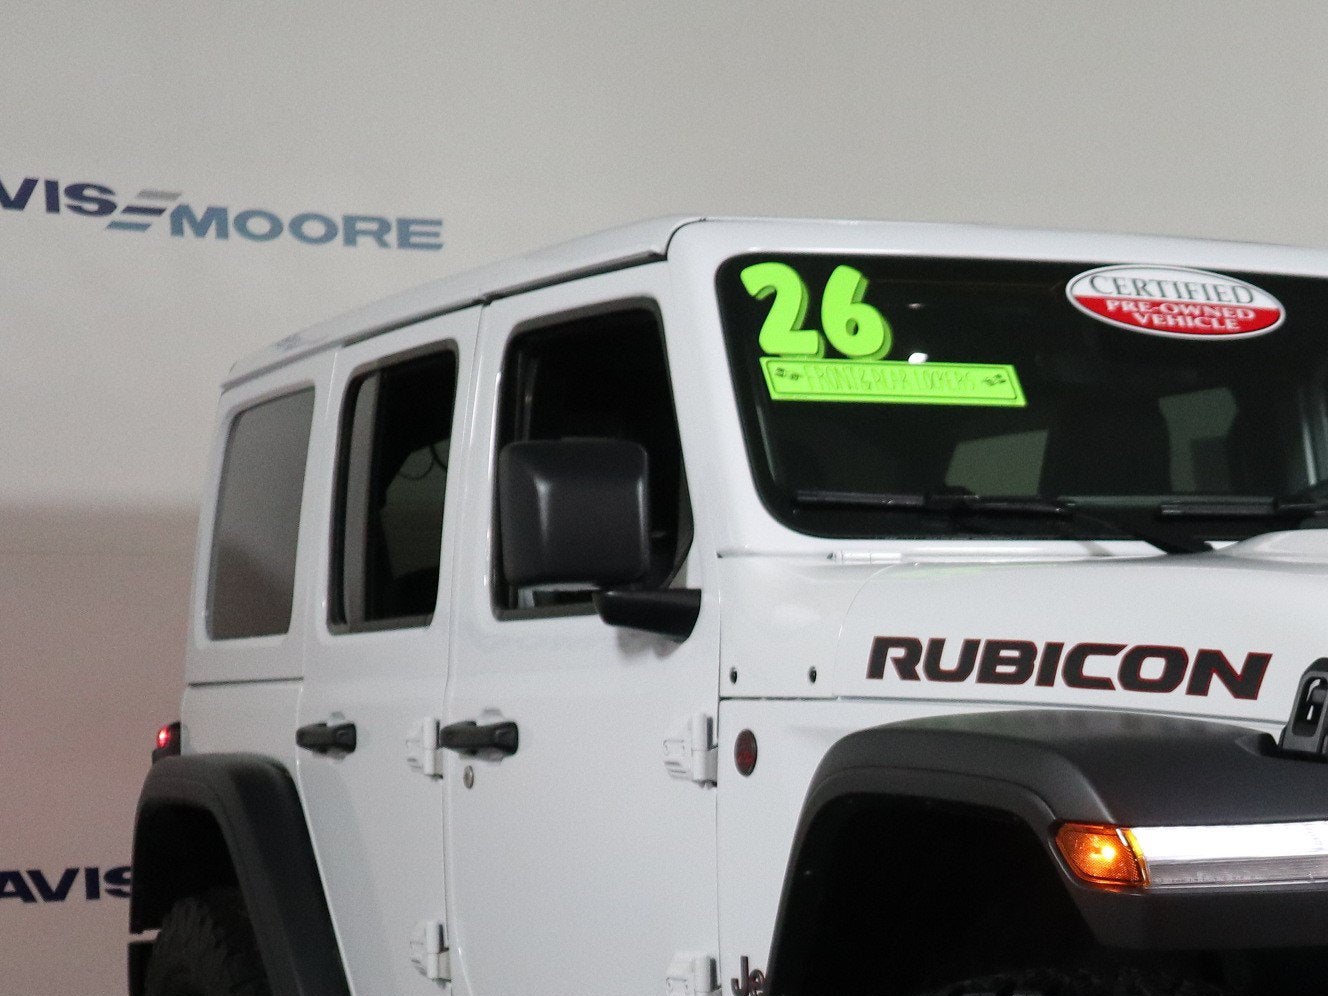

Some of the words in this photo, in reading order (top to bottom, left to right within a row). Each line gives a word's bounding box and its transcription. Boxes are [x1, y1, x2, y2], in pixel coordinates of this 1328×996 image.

[170, 205, 443, 250] MOORE
[1089, 274, 1255, 304] CERTIFIED
[740, 261, 893, 360] 26
[1106, 300, 1256, 320] PRE-OWNED
[1133, 312, 1241, 330] VEHICLE
[866, 635, 1273, 700] RUBICON
